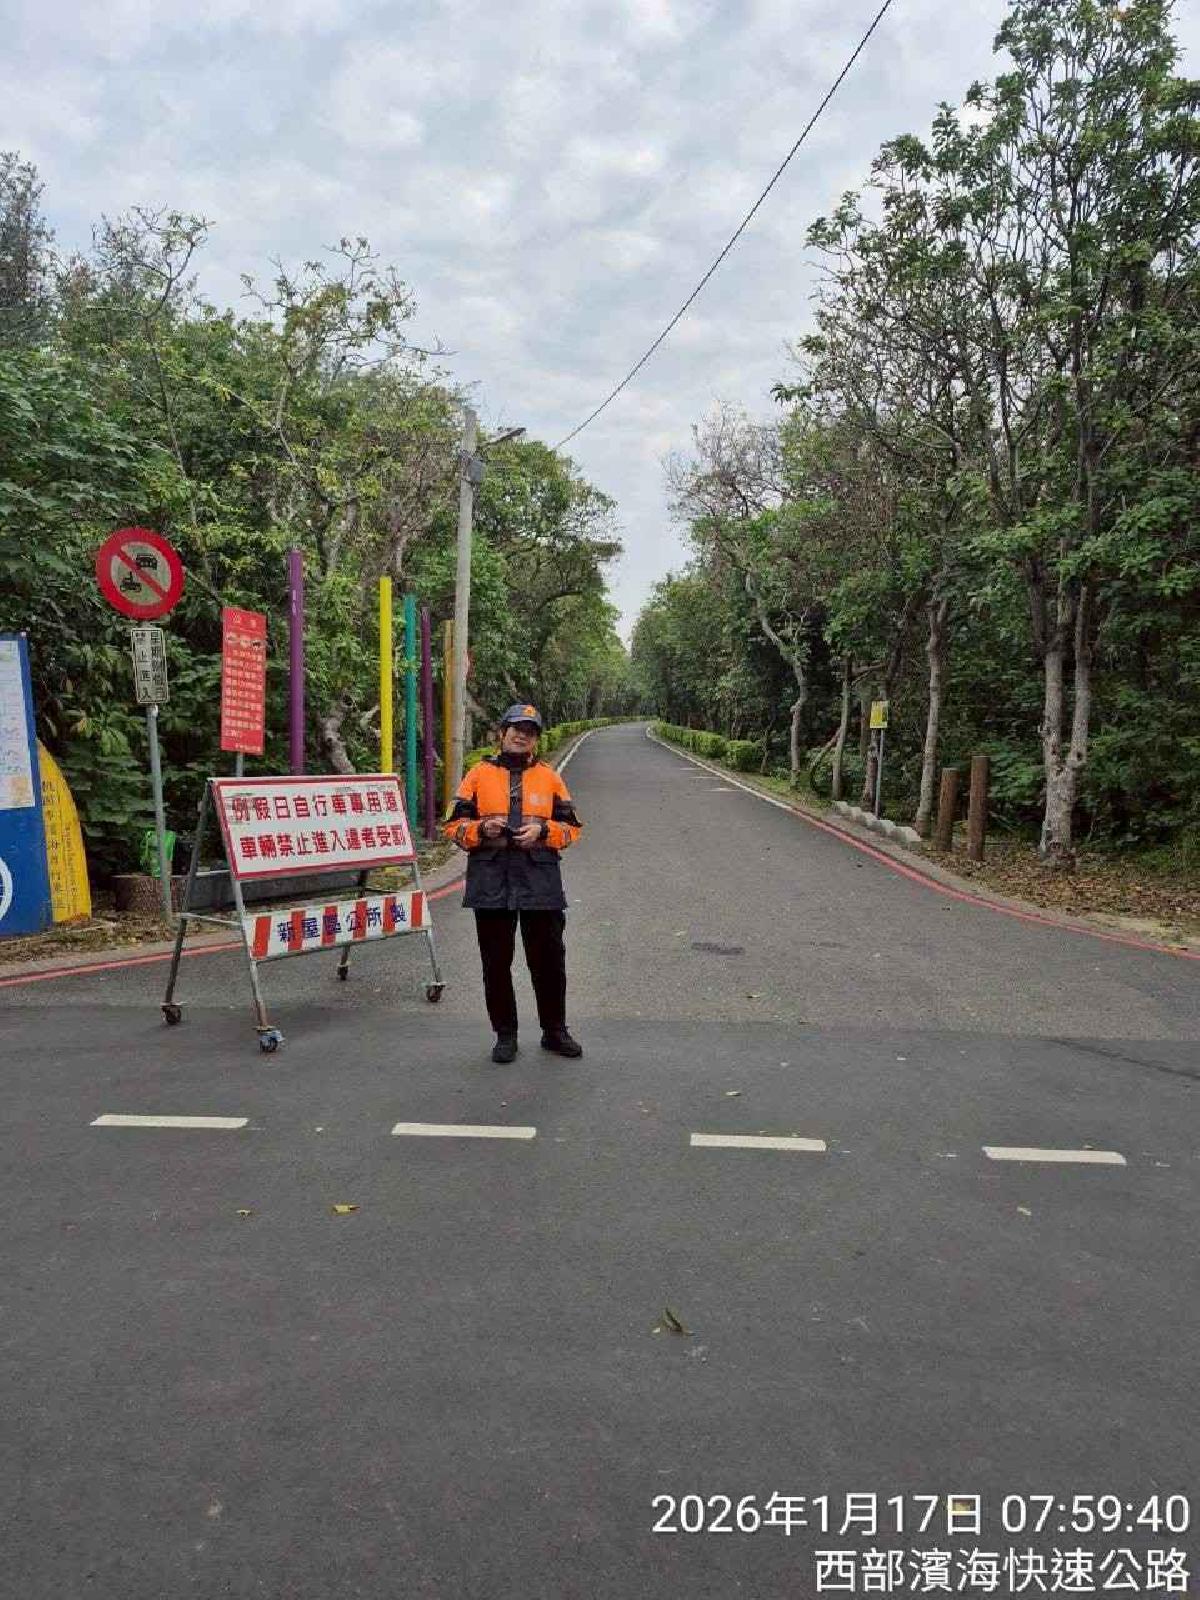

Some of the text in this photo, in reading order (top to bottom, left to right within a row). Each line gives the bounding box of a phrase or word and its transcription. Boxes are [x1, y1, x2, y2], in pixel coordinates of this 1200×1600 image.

[135, 631, 151, 699] 禁止進入
[231, 790, 398, 821] 例假日自行車專用道
[239, 824, 407, 859] 車輛禁止進入違者受罰
